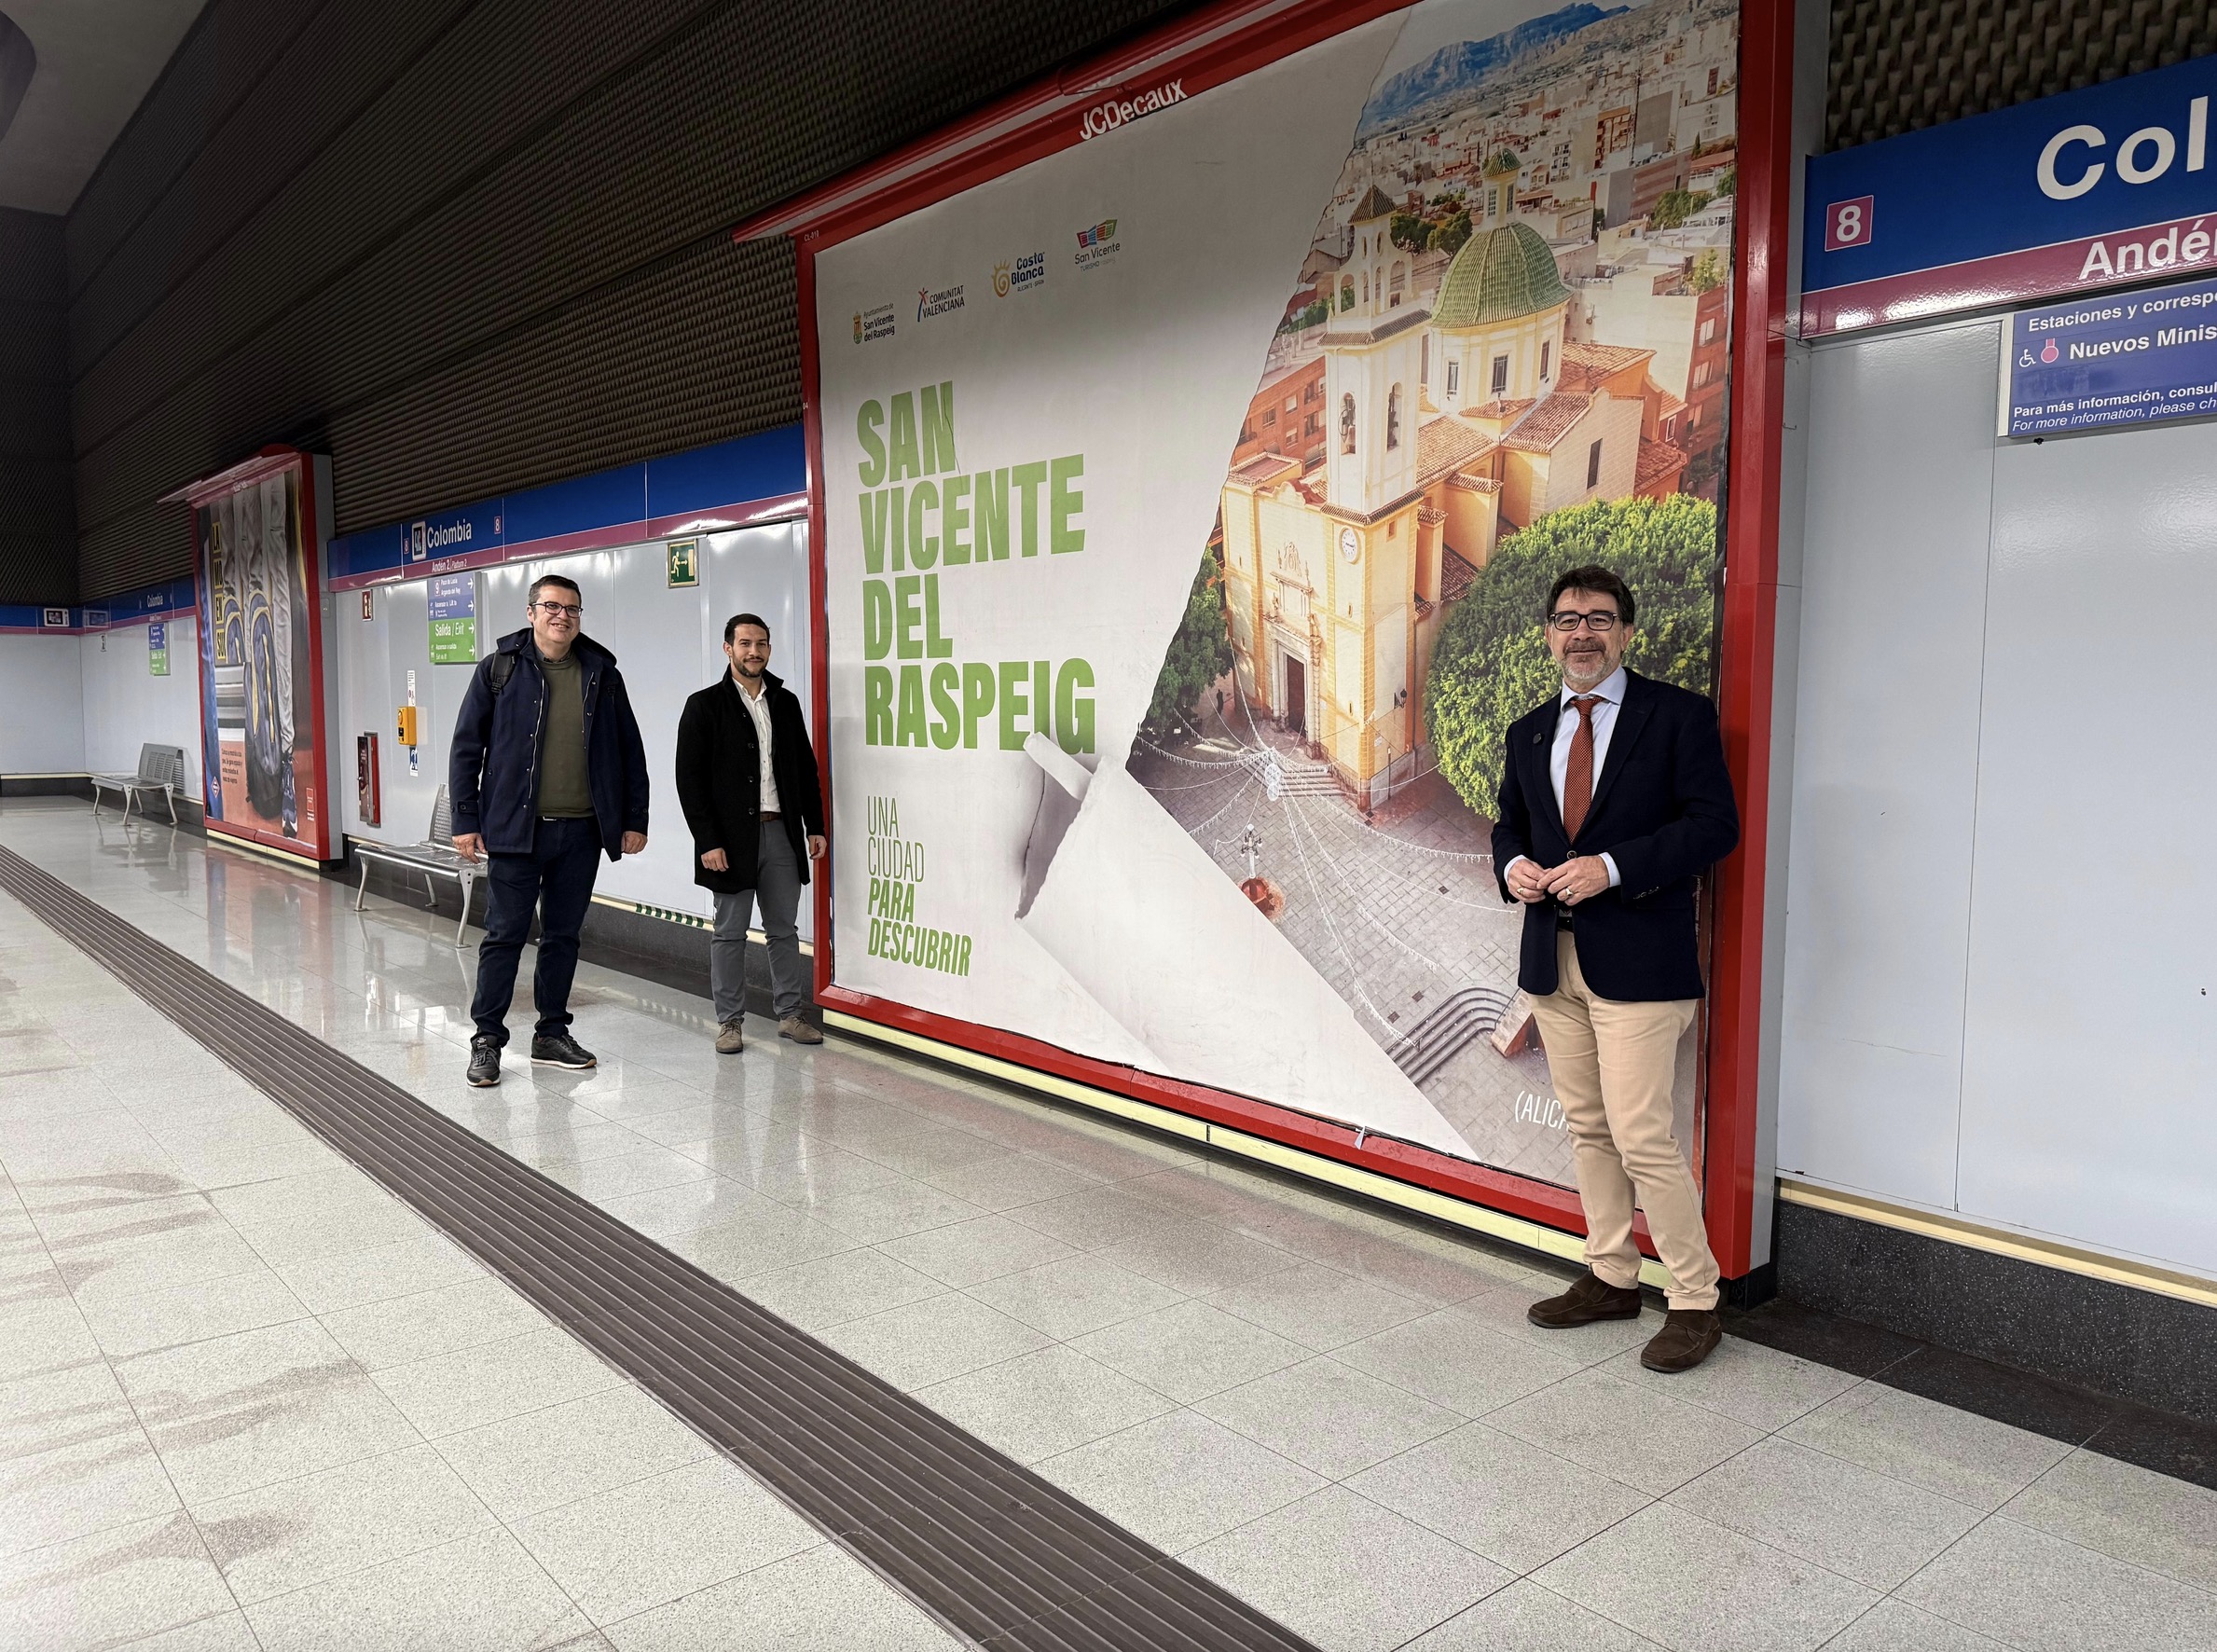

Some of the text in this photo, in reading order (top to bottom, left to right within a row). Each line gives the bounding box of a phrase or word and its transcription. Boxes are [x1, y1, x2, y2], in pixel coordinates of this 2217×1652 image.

[1080, 78, 1189, 140] JCDecaux
[2036, 95, 2209, 200] Col
[1836, 204, 1862, 242] 8
[1016, 252, 1045, 270] Costa
[1074, 253, 1090, 265] San
[1091, 242, 1121, 259] Vicente
[1011, 266, 1044, 285] Blanca
[922, 296, 966, 319] VALENCIANA
[929, 284, 964, 305] COMUNITAT
[2028, 292, 2217, 333] Estaciones y corresp
[863, 313, 895, 331] San Vicente
[863, 324, 895, 342] del Raspeig
[2069, 324, 2217, 360] Nuevos Minis
[2012, 397, 2217, 432] For more information, please ch
[2014, 381, 2217, 418] Para más información, consul
[856, 379, 957, 489] SAN
[495, 518, 501, 532] 8
[858, 453, 1086, 574] VICENTE
[427, 518, 472, 549] Colombia
[432, 559, 447, 572] Andén
[434, 622, 451, 637] Salida
[455, 622, 464, 635] Exit
[862, 572, 954, 661] DEL
[864, 657, 1095, 755] RASPEIG
[867, 795, 899, 838] UNA
[867, 835, 925, 883] CIUDAD
[867, 876, 915, 923] PARA
[867, 917, 973, 977] DESCUBRIR
